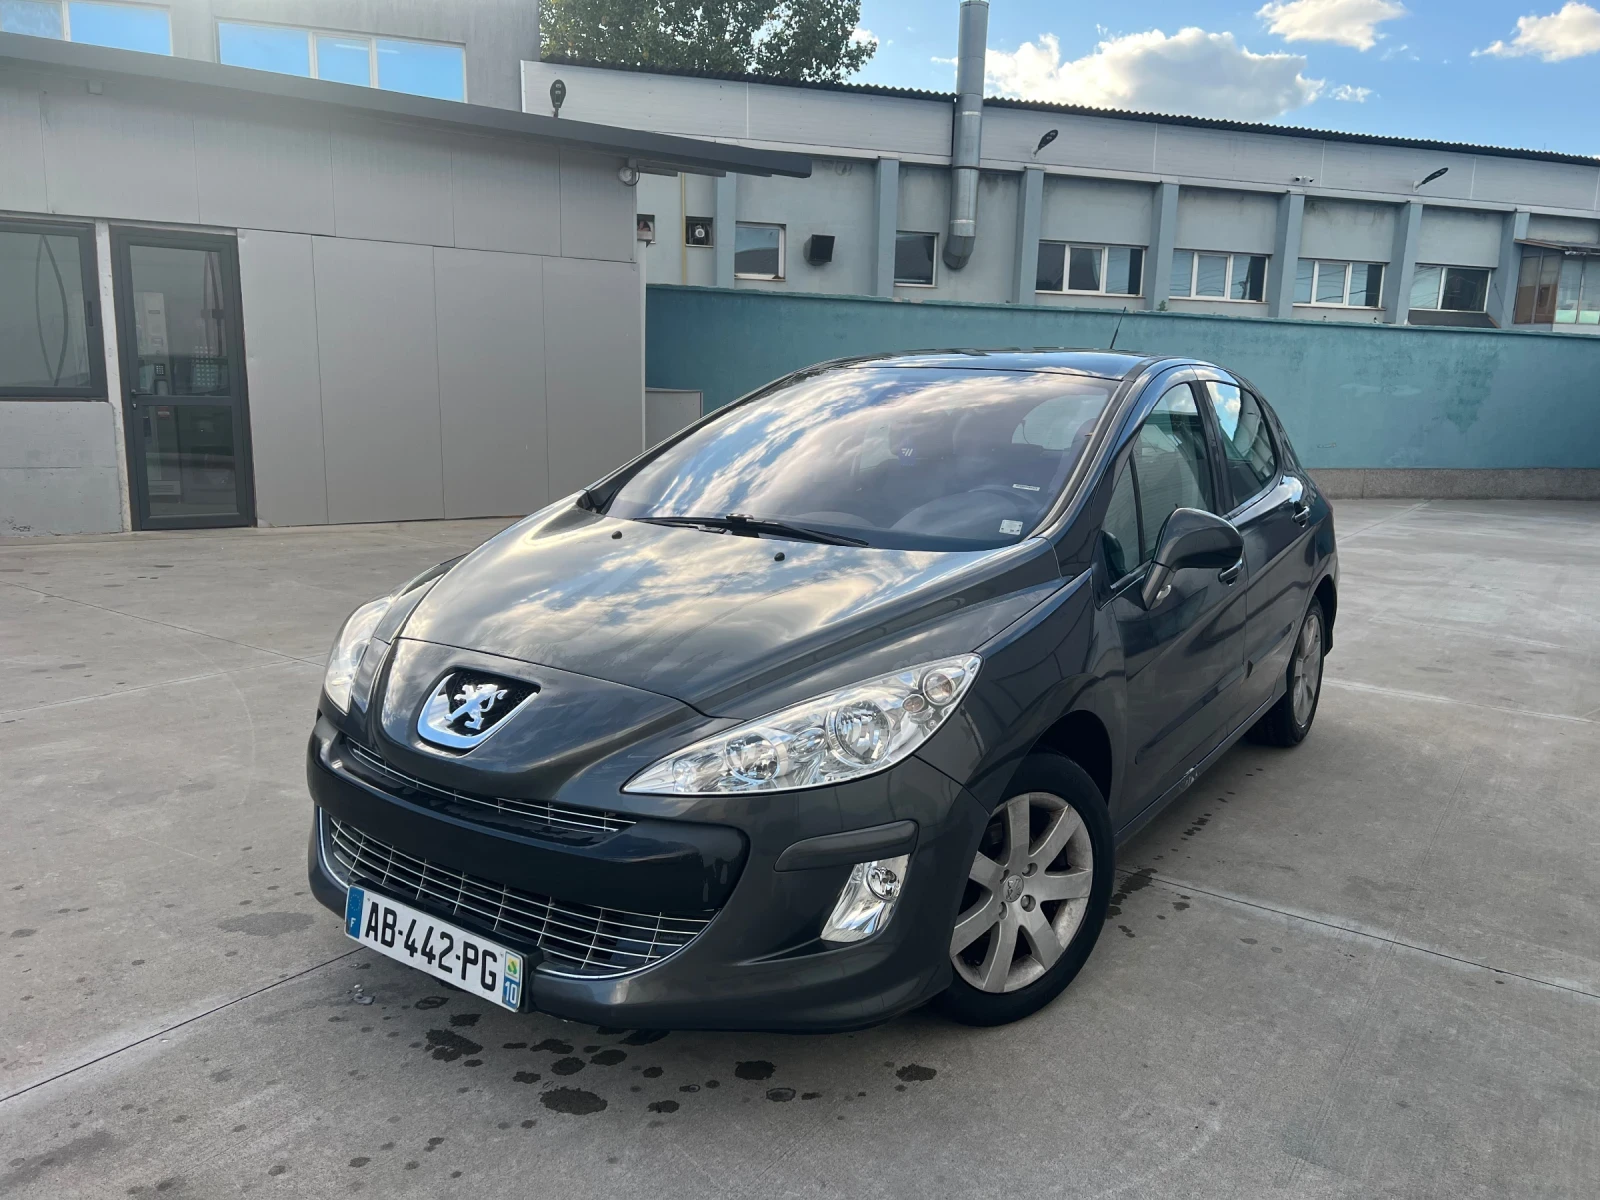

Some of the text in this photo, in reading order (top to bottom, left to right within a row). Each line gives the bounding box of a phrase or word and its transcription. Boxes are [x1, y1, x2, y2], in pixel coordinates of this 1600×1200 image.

[350, 917, 356, 928] F
[365, 902, 498, 992] AB-442-PG
[504, 981, 518, 1005] 10
